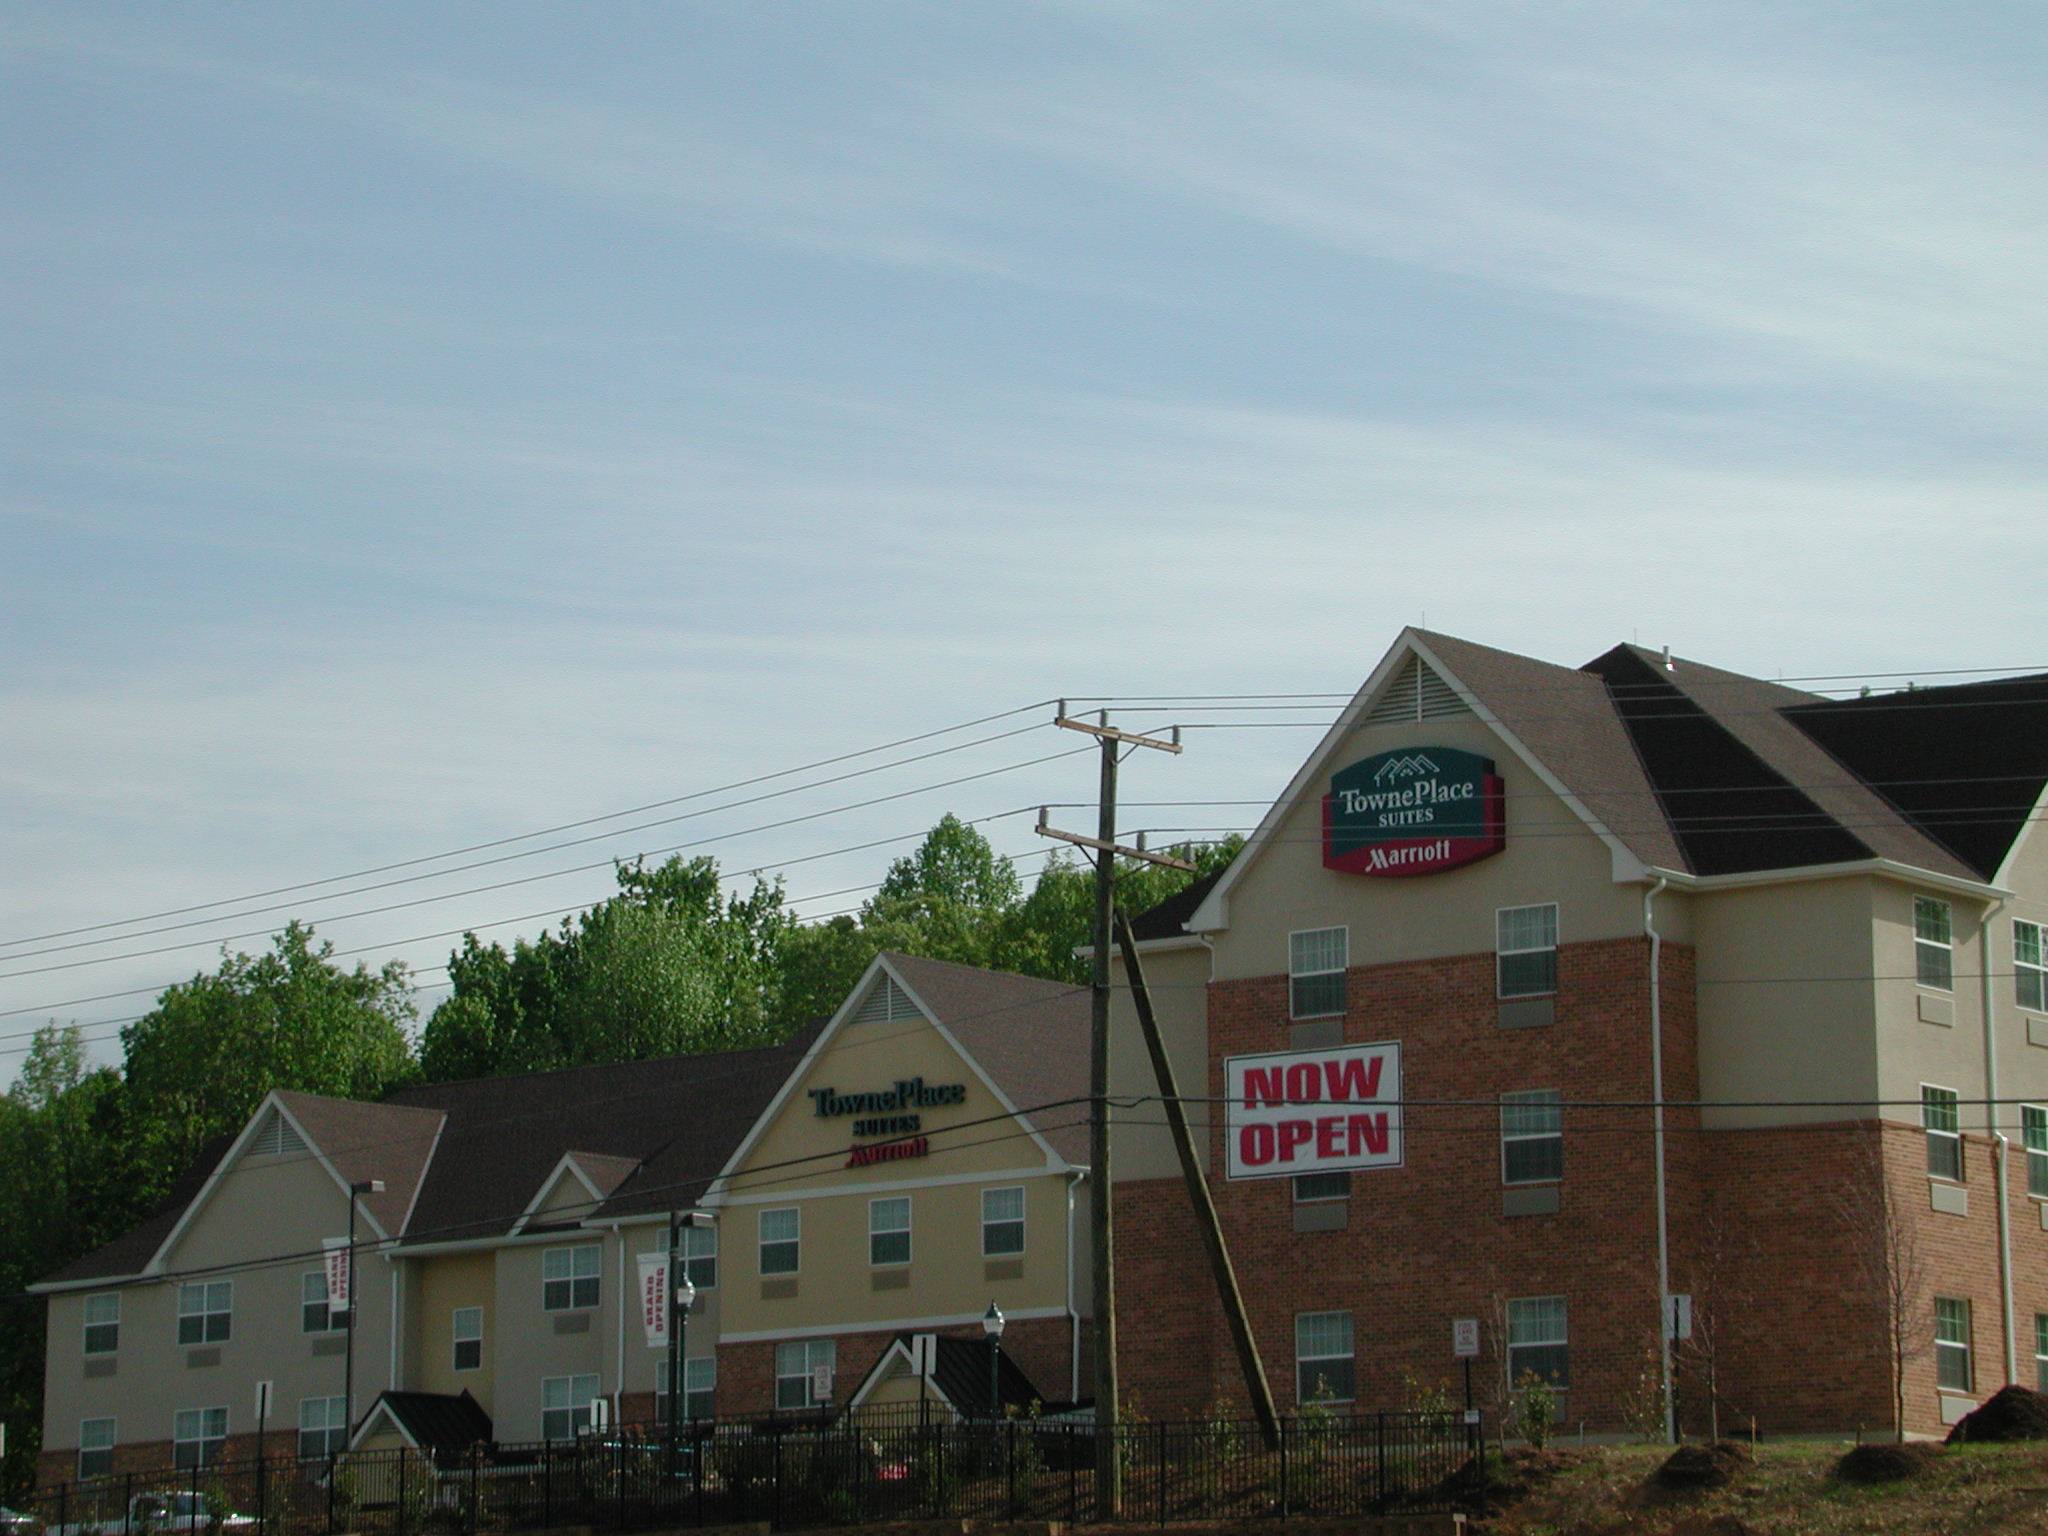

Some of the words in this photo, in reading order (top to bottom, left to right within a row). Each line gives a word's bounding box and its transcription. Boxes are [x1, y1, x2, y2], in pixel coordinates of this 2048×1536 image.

[1339, 778, 1474, 814] TownePlace
[1378, 808, 1434, 828] SUITES
[1365, 839, 1450, 873] Marriott
[807, 1076, 966, 1118] TownePlace
[1243, 1056, 1384, 1110] NOW
[852, 1115, 921, 1136] SUITES
[1239, 1111, 1388, 1167] OPEN
[844, 1137, 929, 1168] Marriott
[646, 1275, 654, 1325] GRAND
[655, 1267, 665, 1332] OPENING
